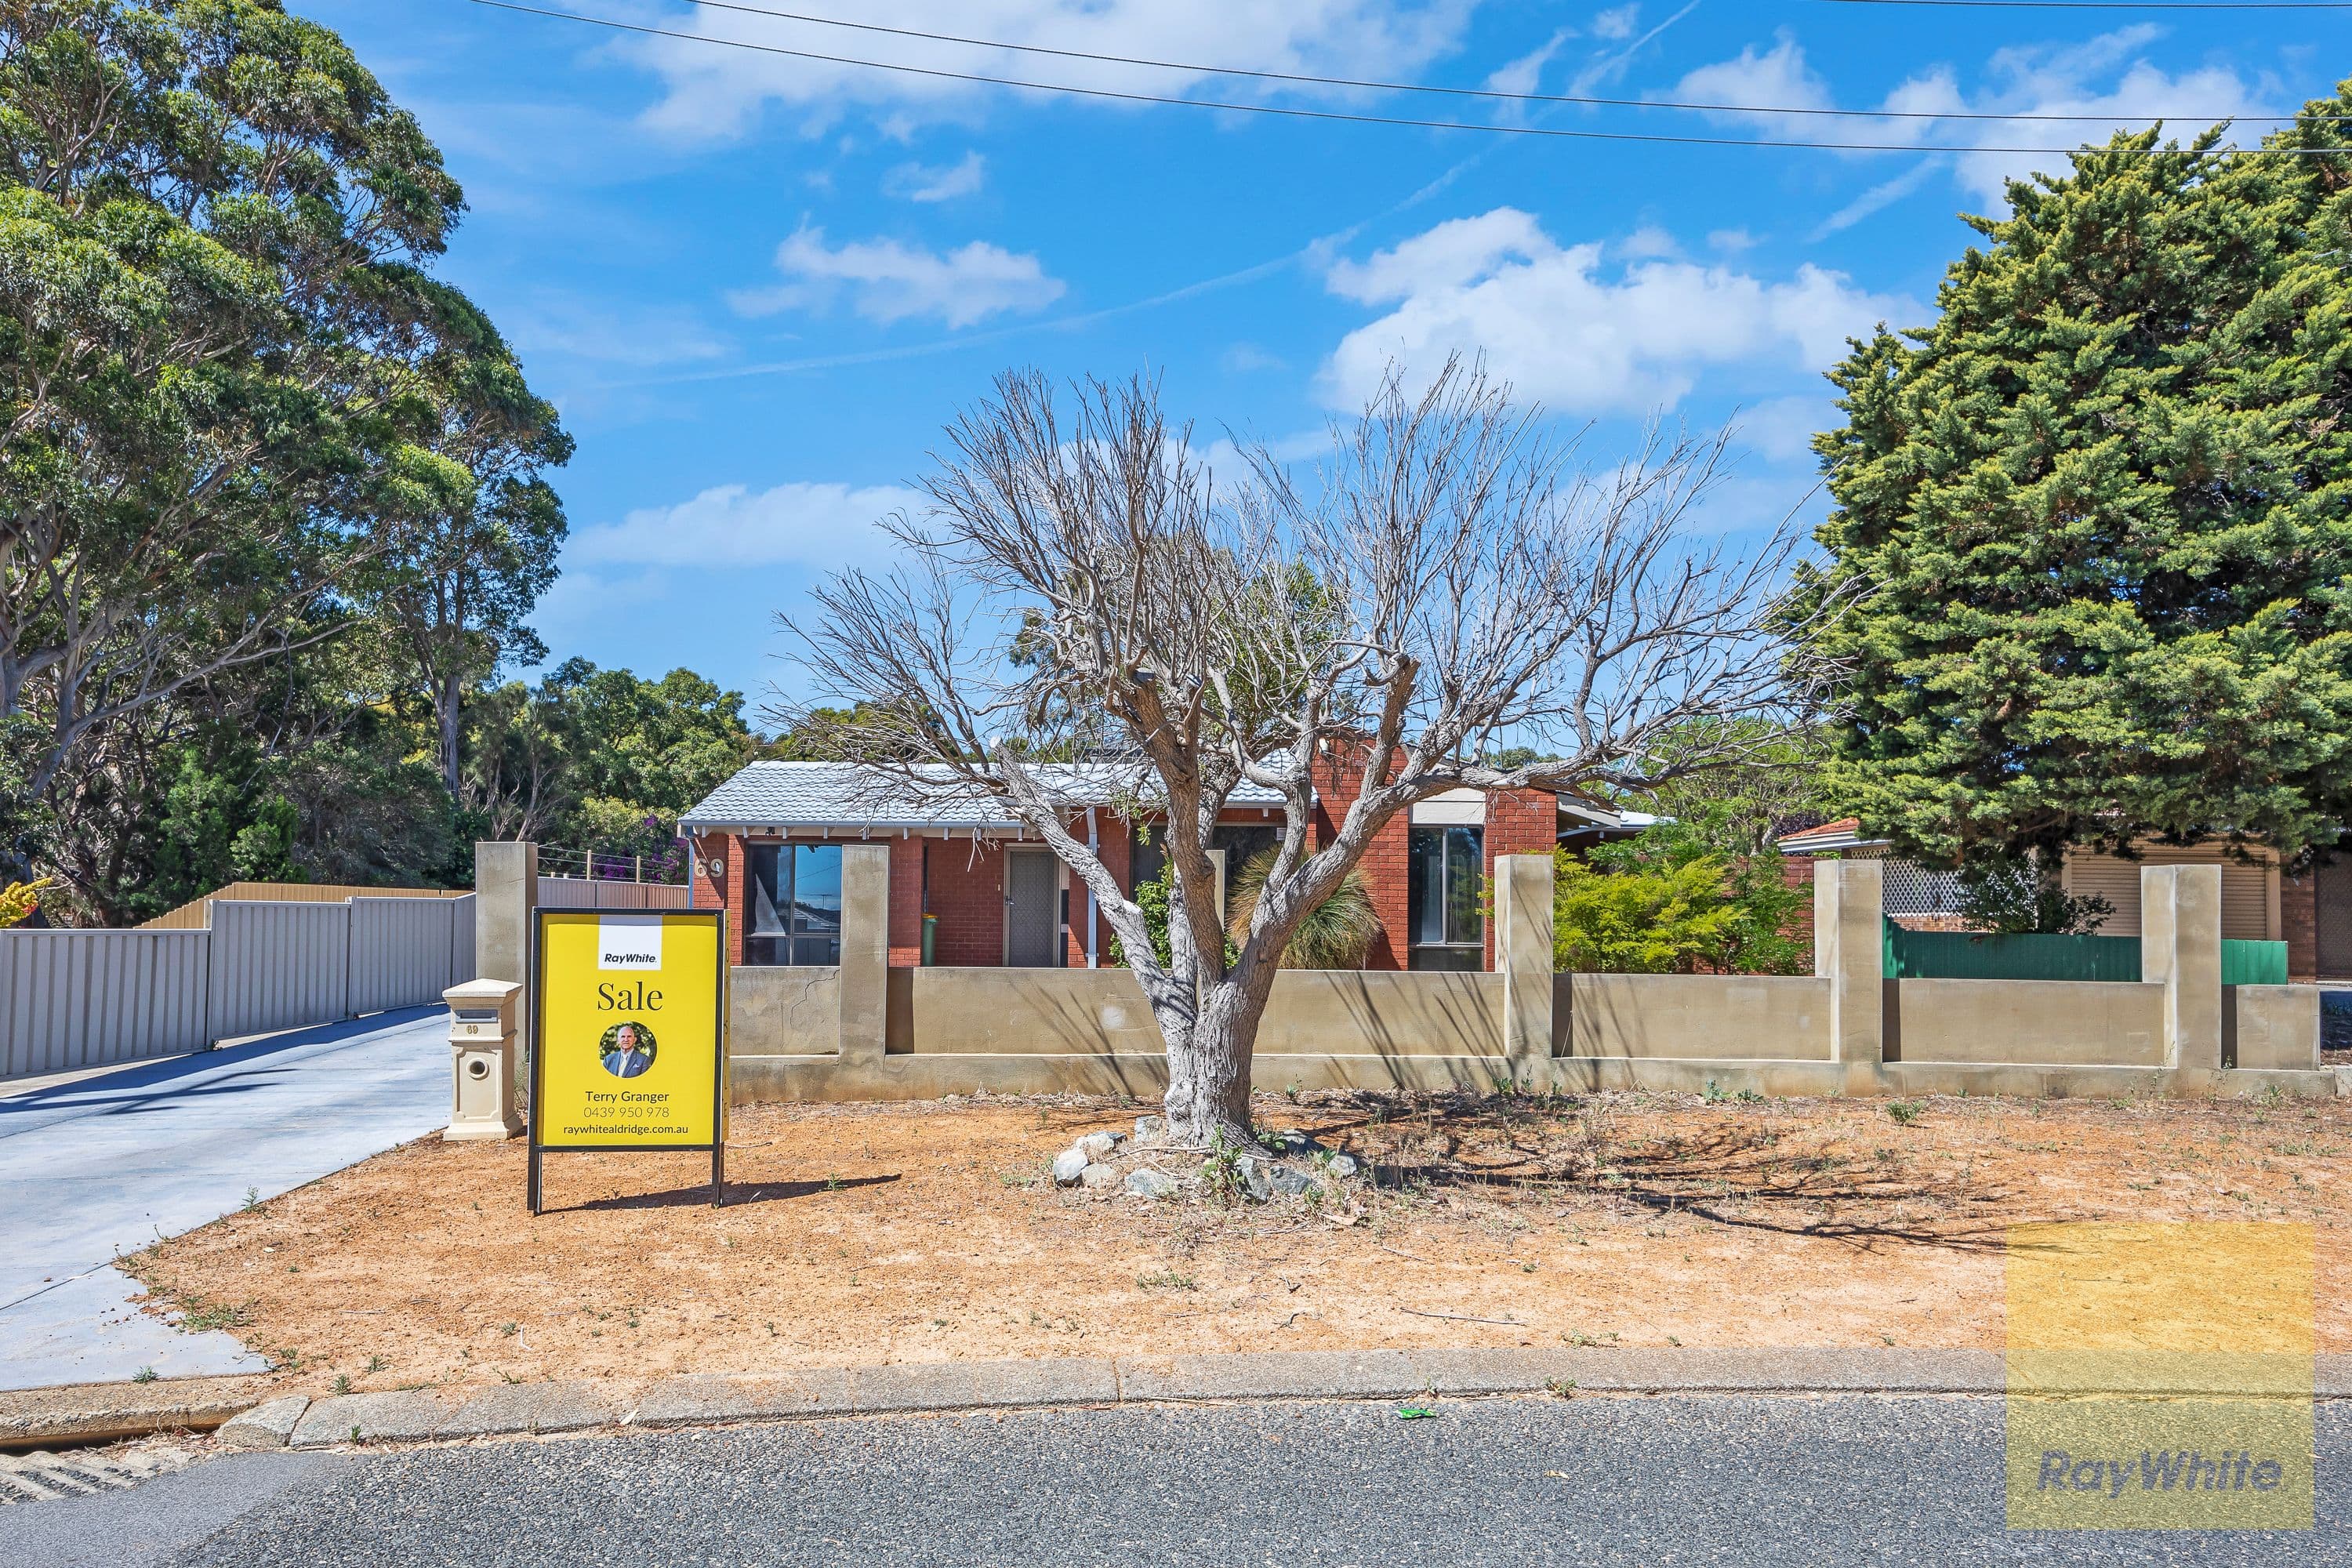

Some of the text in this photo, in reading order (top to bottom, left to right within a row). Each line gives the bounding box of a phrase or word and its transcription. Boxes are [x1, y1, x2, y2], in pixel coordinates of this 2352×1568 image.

[694, 858, 724, 878] 69
[604, 953, 656, 964] RayWhite
[597, 981, 663, 1011] Sale
[585, 1091, 670, 1104] Terry Granger
[583, 1107, 670, 1118] 0439 950 978
[563, 1123, 688, 1135] raywhitealdridge.com.au
